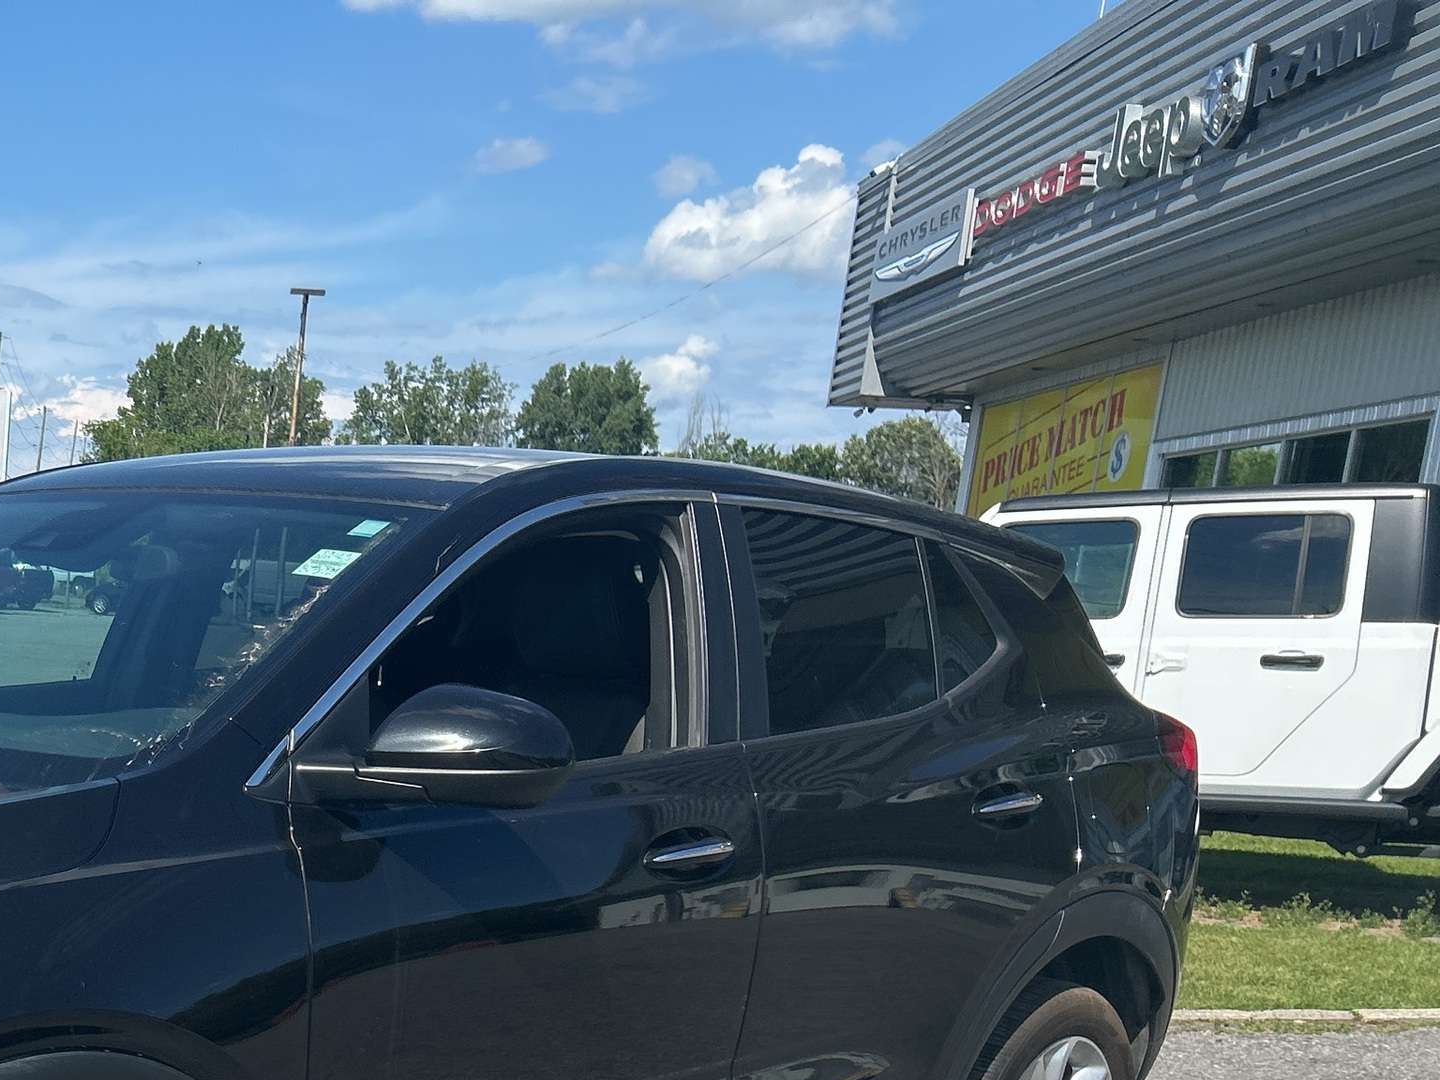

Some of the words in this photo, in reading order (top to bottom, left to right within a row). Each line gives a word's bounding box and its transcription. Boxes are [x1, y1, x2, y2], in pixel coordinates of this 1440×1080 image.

[1253, 0, 1398, 107] RAM
[1094, 95, 1198, 189] Jeep
[878, 204, 960, 258] CHRYSLER
[972, 150, 1098, 237] DODGE
[981, 432, 1042, 494] PRICE
[1044, 388, 1127, 462] MATCH
